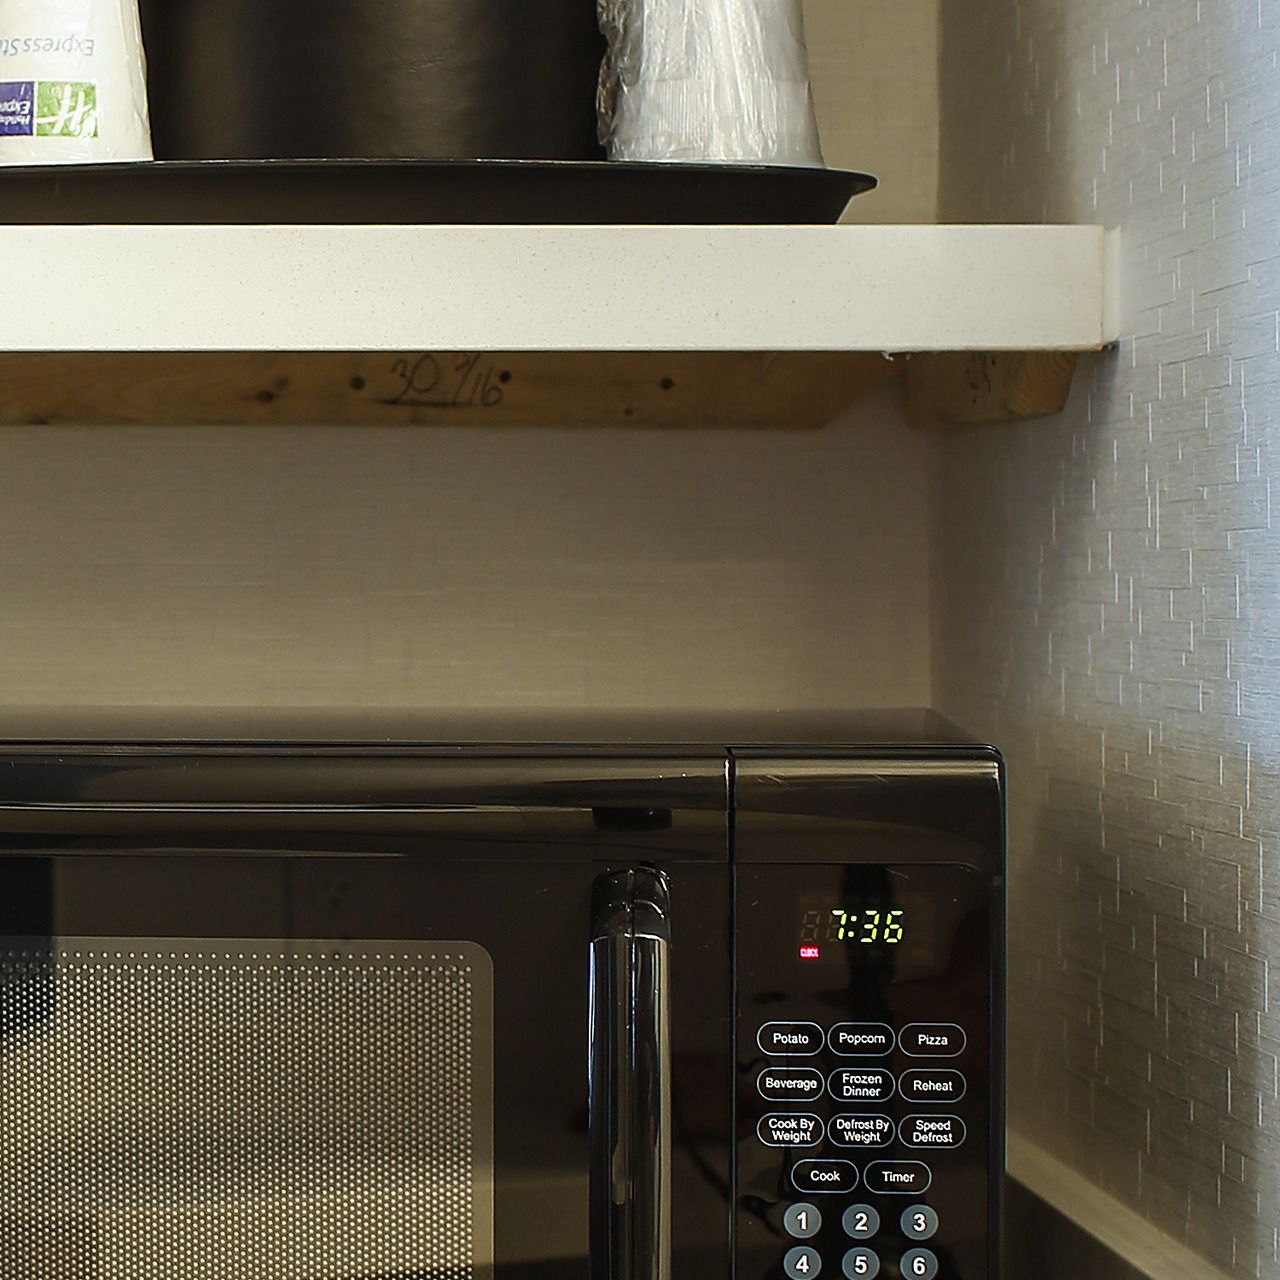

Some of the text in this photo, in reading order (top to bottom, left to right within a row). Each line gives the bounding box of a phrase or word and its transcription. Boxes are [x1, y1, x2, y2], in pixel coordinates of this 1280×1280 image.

[23, 33, 95, 57] Express
[831, 908, 904, 943] 7:36
[772, 1032, 809, 1045] Potato
[838, 1032, 886, 1047] Popcorn
[917, 1033, 949, 1046] Pizza
[765, 1077, 818, 1091] Beverage
[841, 1073, 883, 1085] Frozen
[912, 1079, 953, 1092] Reheat
[842, 1086, 881, 1097] Dinner
[768, 1118, 816, 1132] Cook By
[836, 1119, 890, 1133] Defrost By
[915, 1120, 952, 1133] Speed
[771, 1130, 812, 1143] Weight
[843, 1130, 881, 1144] Weight
[912, 1131, 953, 1143] Defrost
[809, 1170, 841, 1182] Cook
[881, 1170, 916, 1183] Timer
[796, 1212, 807, 1230] 1
[855, 1213, 868, 1231] 2
[913, 1213, 926, 1232] 3
[795, 1255, 809, 1273] 4
[855, 1256, 868, 1274] 5
[913, 1257, 925, 1274] 6
